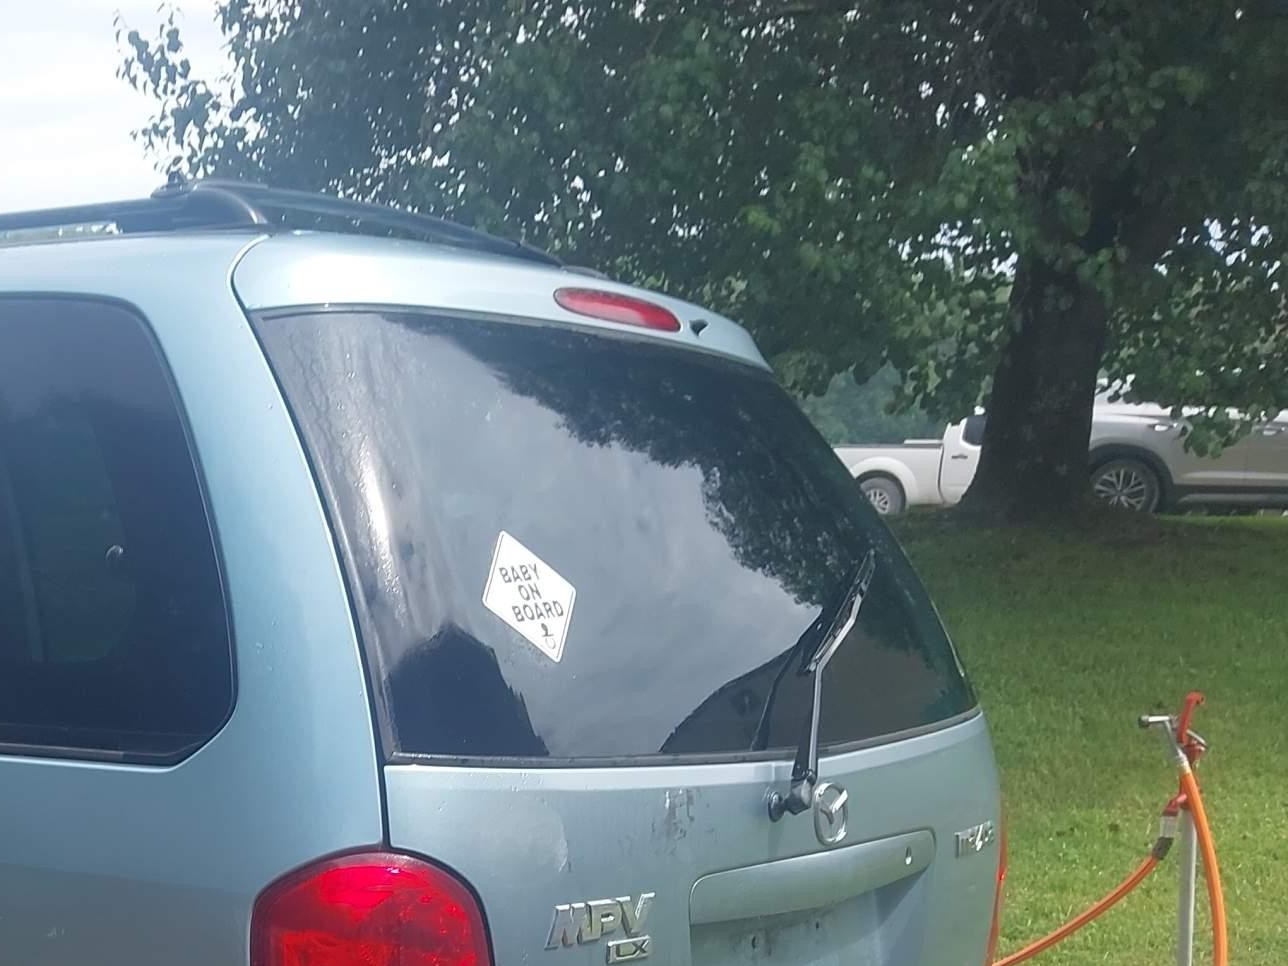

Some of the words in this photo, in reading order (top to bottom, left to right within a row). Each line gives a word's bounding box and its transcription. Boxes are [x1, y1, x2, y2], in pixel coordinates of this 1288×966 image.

[498, 563, 540, 584] BABY
[517, 584, 543, 602] ON
[511, 600, 565, 622] BOARD
[544, 891, 656, 950] MPV
[610, 937, 651, 963] LX
